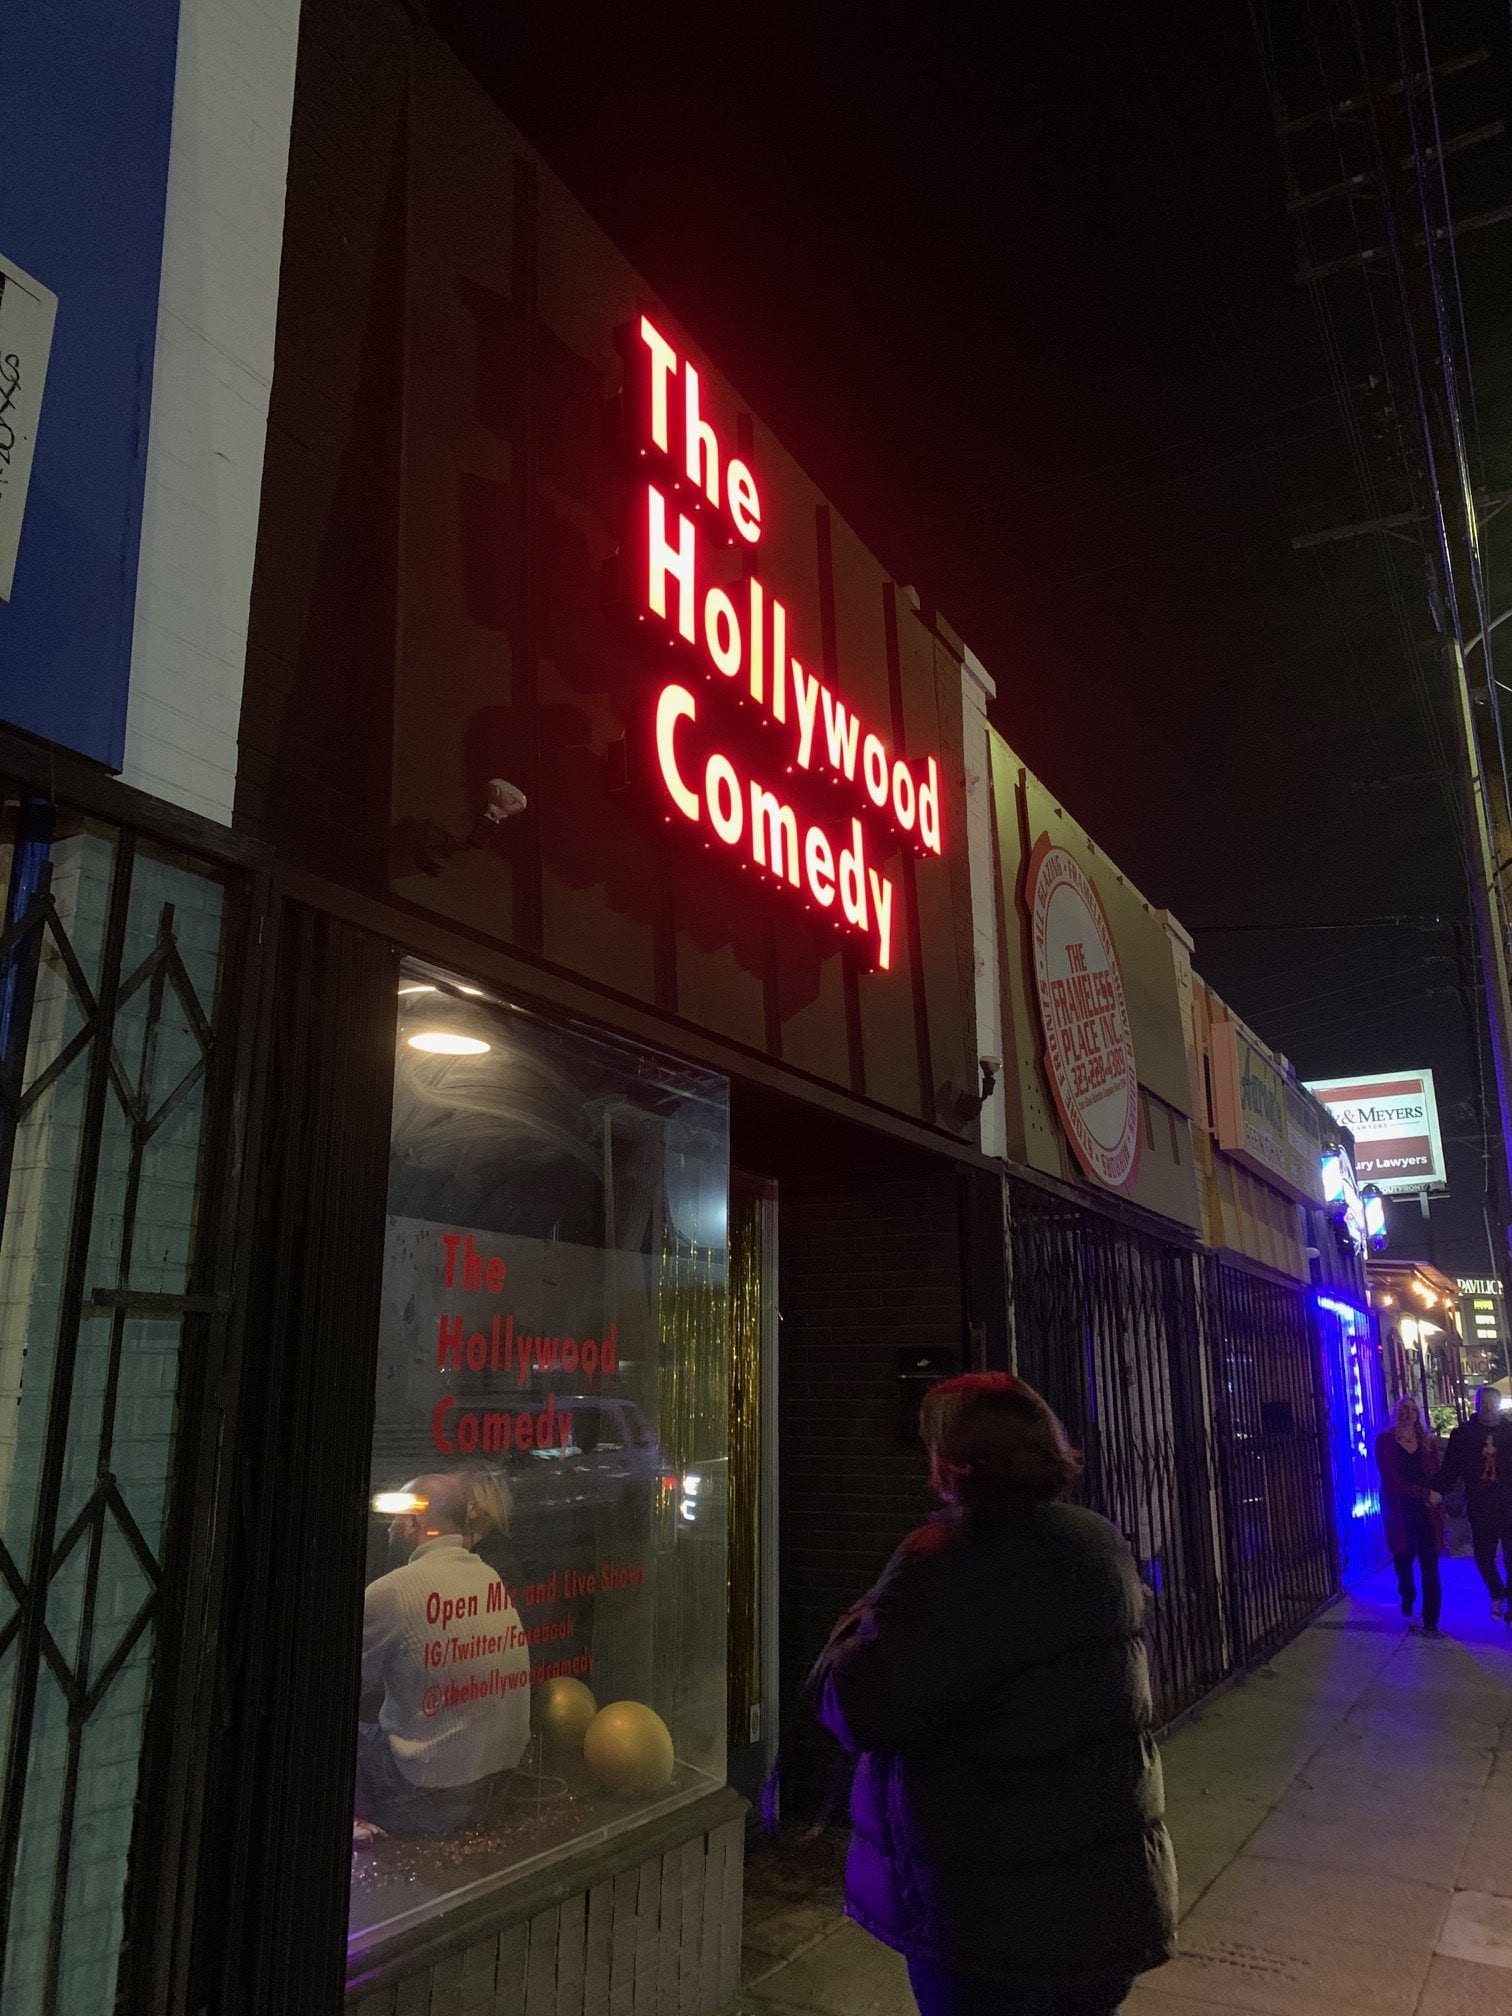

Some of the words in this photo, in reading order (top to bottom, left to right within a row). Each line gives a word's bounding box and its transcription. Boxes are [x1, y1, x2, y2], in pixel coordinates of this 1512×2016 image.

[641, 314, 761, 543] The
[648, 484, 941, 855] Hollywood
[656, 683, 892, 970] Comedy
[1037, 855, 1062, 908] GLAZING
[1065, 943, 1087, 974] THE
[1050, 969, 1116, 1027] FRAMELESS
[1060, 1021, 1100, 1065] PLACE
[1099, 1012, 1123, 1048] INC.
[1358, 1106, 1423, 1123] MEYERS
[1375, 1156, 1428, 1168] Lawyers
[443, 1233, 507, 1295] The
[437, 1313, 618, 1388] Hollywood
[432, 1393, 573, 1458] Comedy
[426, 1592, 478, 1630] Open
[486, 1581, 519, 1613] Mic
[524, 1570, 557, 1606] and
[561, 1569, 594, 1599] Live
[599, 1560, 646, 1591] Shows
[424, 1614, 576, 1669] IG/Twitter/Facebook
